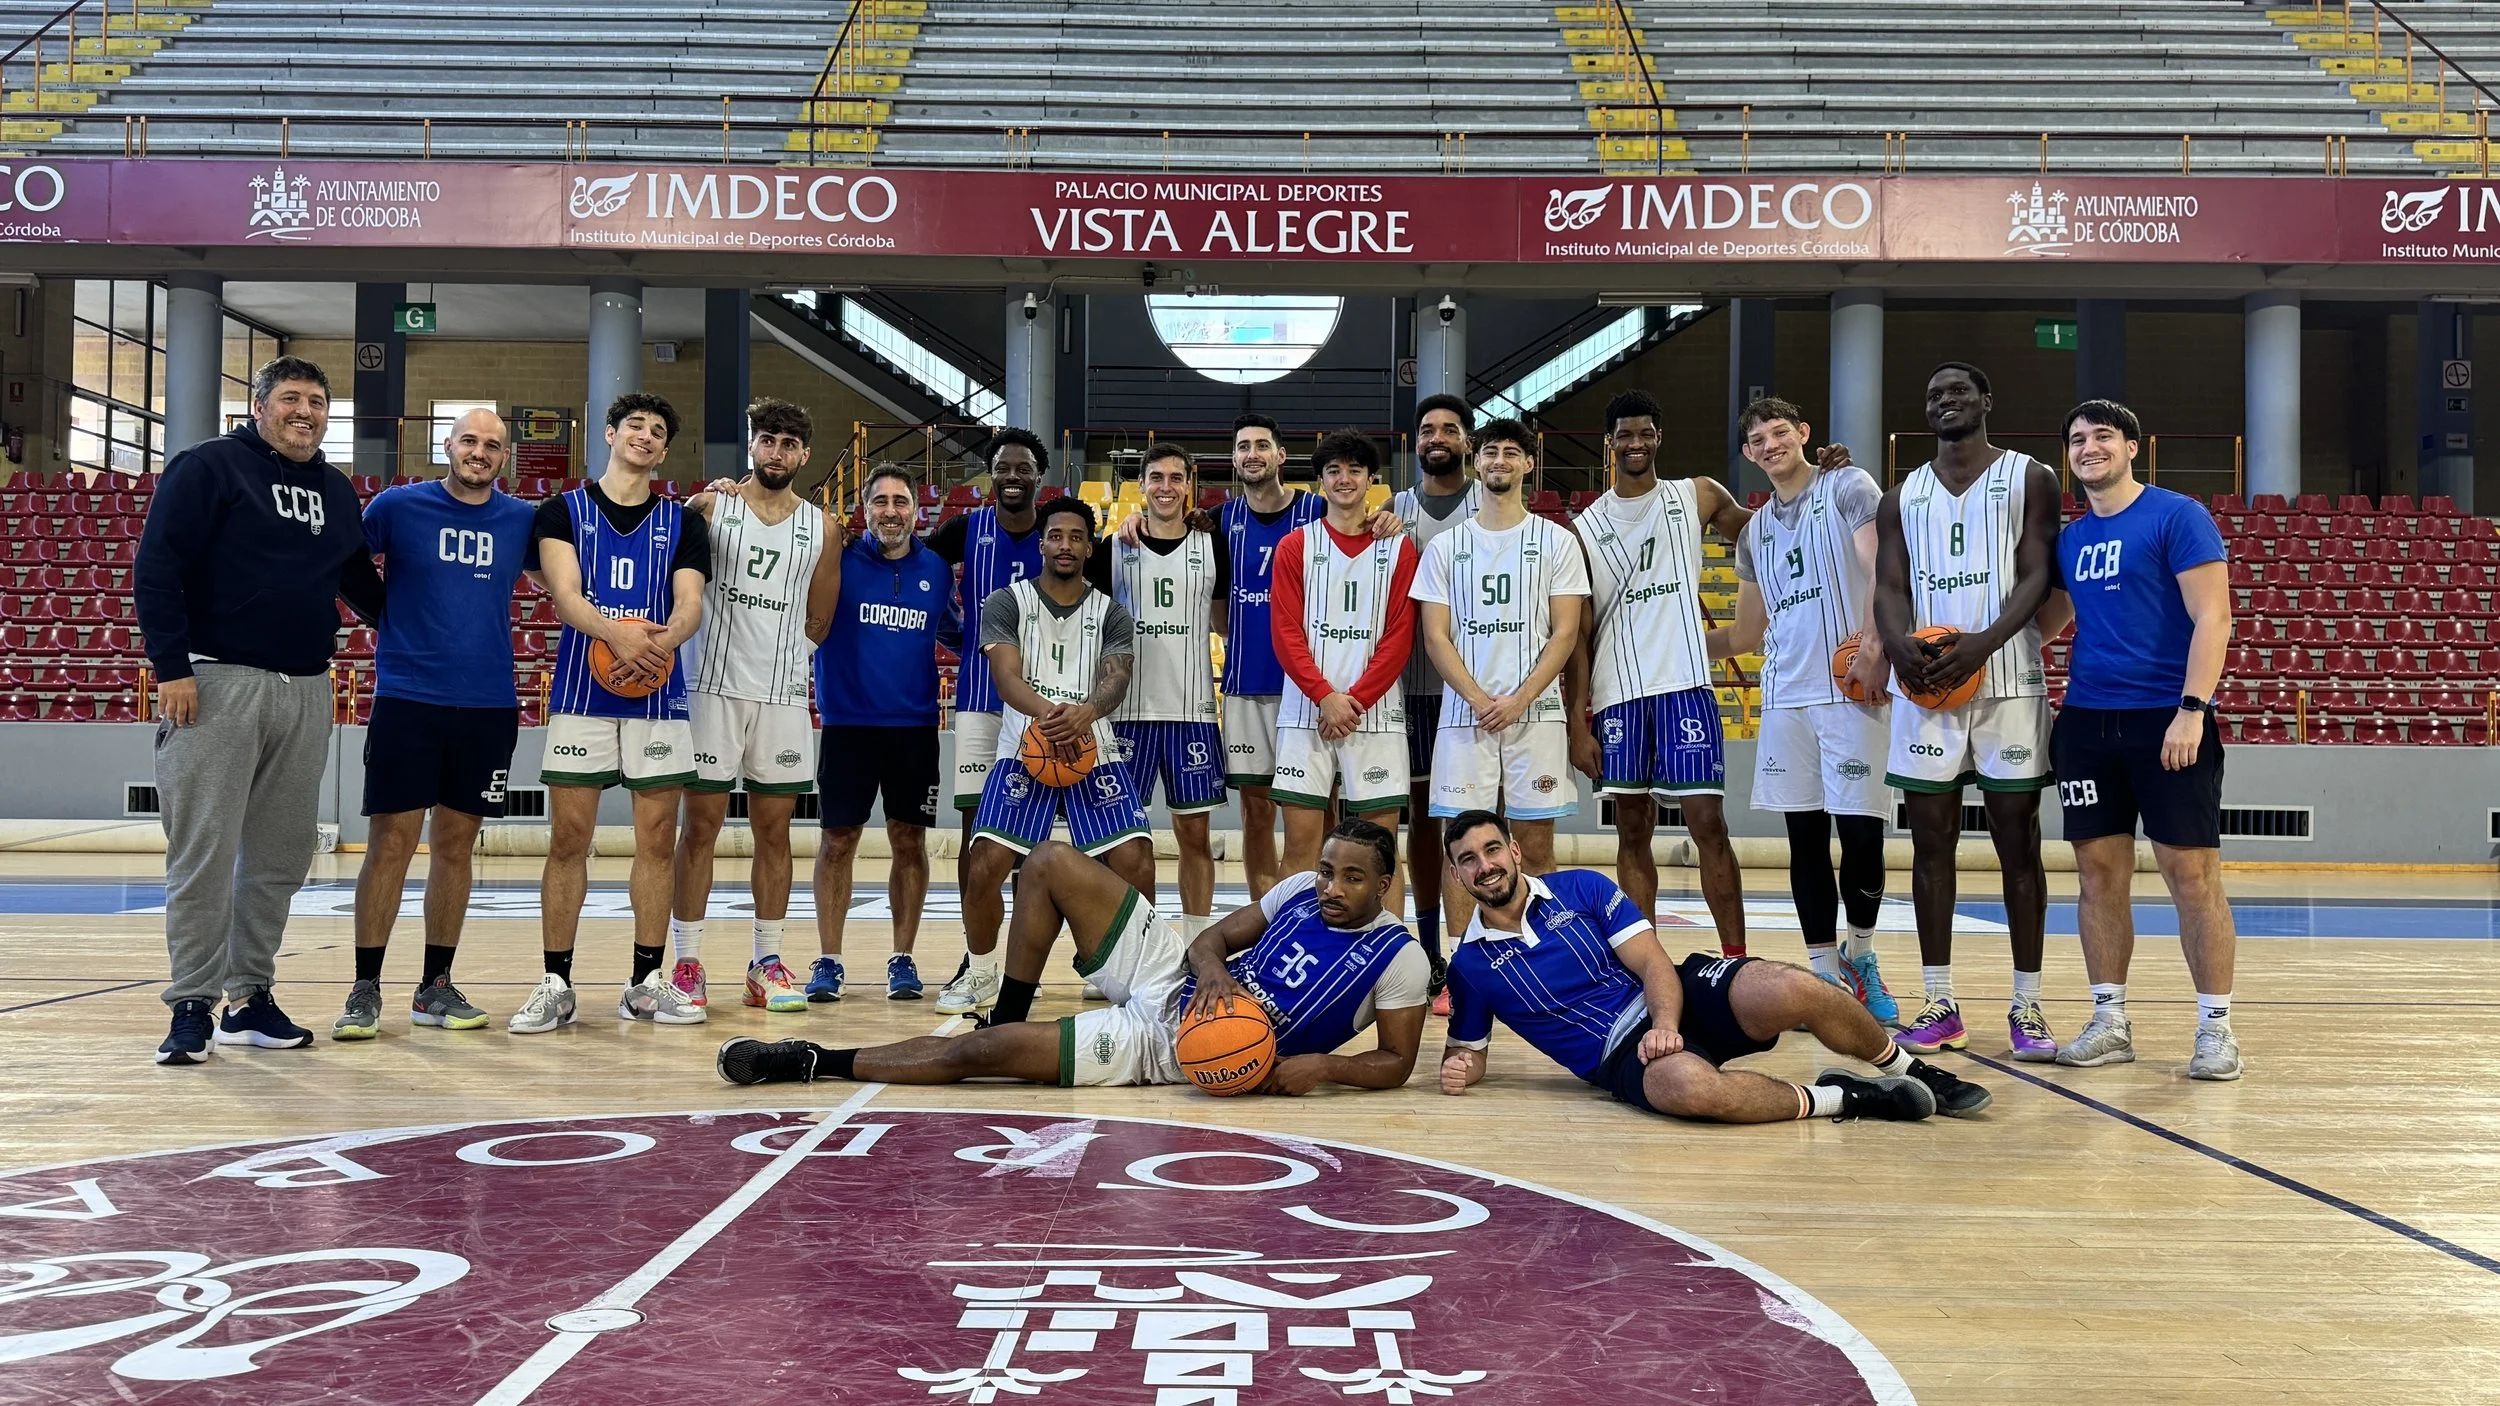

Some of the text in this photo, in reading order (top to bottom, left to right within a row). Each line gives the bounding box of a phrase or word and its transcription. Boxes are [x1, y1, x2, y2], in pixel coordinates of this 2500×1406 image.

[0, 165, 65, 212] O
[316, 181, 440, 205] AYUNTAMIENTO
[646, 173, 898, 223] IMDECO
[1055, 181, 1383, 203] PALACIO MUNICIPAL DEPORTES
[316, 202, 422, 228] DE CÓRDOBA
[1622, 182, 1873, 231] IMDECO
[2074, 195, 2198, 220] AYUNTAMIENTO
[570, 229, 895, 250] Instituto Municipal de Deportes Córdoba
[1030, 207, 1414, 254] VISTA ALEGRE
[2074, 216, 2180, 243] DE CÓRDOBA
[1545, 240, 1870, 259] Instituto Municipal de Deportes Córdoba
[2382, 243, 2448, 258] Instituto
[405, 307, 424, 328] G
[271, 483, 325, 527] CCB
[438, 527, 494, 568] CCB
[1949, 522, 1965, 557] 8
[746, 545, 781, 580] 27
[1257, 546, 1273, 576] 7
[1639, 536, 1656, 572] 17
[2075, 539, 2122, 582] CCB
[610, 555, 634, 590] 10
[1928, 570, 1991, 595] Sepisur
[727, 587, 789, 613] Sepisur
[1152, 577, 1174, 608] 16
[1238, 588, 1271, 607] Sepi
[1343, 580, 1358, 612] 11
[1481, 573, 1511, 606] 50
[1625, 580, 1682, 605] Sepisur
[599, 604, 651, 621] episur
[1135, 620, 1190, 639] Sepisur
[1467, 618, 1526, 639] Sepisur
[1051, 643, 1065, 675] 4
[1031, 678, 1084, 701] Sepisur
[553, 744, 588, 757] coto
[694, 752, 718, 765] oto
[1229, 743, 1255, 754] coto
[1909, 743, 1944, 757] coto
[959, 762, 987, 774] coto
[1276, 765, 1305, 778] coto
[486, 769, 507, 803] CCB
[2060, 779, 2099, 807] CCB
[1272, 941, 1320, 989] 35
[1490, 948, 1515, 971] coto
[1243, 970, 1292, 1028] Sepisur
[1193, 1056, 1261, 1086] Wilson
